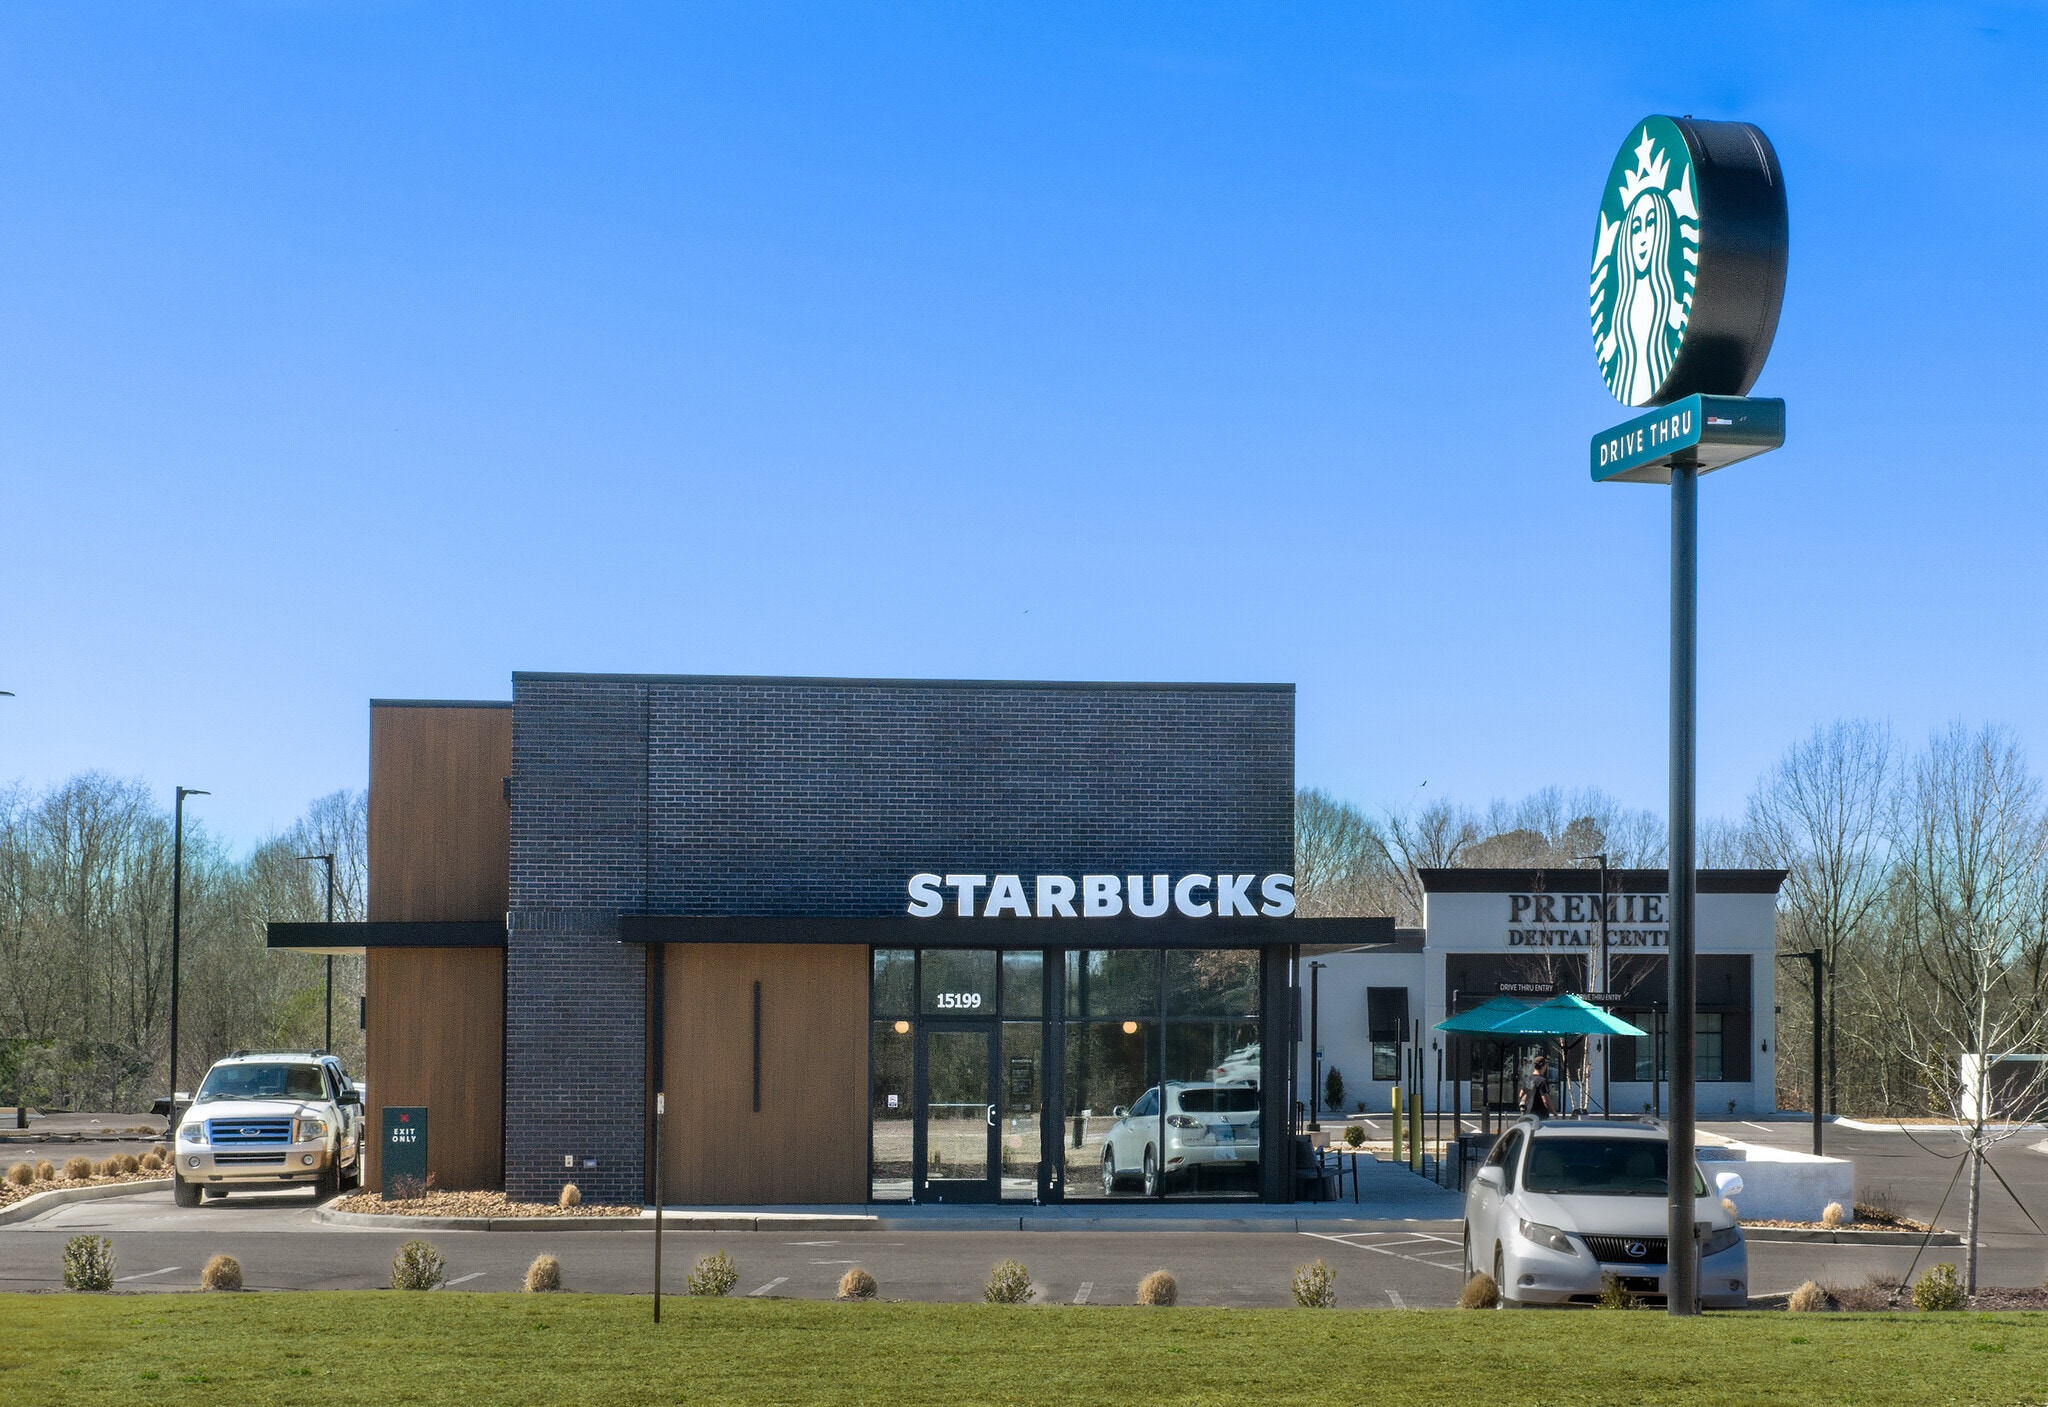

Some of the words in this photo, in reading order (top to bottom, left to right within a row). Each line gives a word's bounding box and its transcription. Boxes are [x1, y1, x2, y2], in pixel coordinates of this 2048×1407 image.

[1600, 429, 1643, 467] DRIVE
[1650, 410, 1691, 447] THRU
[906, 873, 1296, 918] STARBUCKS
[1508, 894, 1669, 923] PREMIE
[1606, 929, 1669, 947] CENT
[1500, 983, 1518, 991] DRIVE
[1518, 983, 1534, 992] THRU
[1535, 984, 1554, 992] ENTRY
[937, 993, 981, 1008] 15199
[1591, 993, 1605, 1001] THRU
[1606, 993, 1621, 1001] ENTRY
